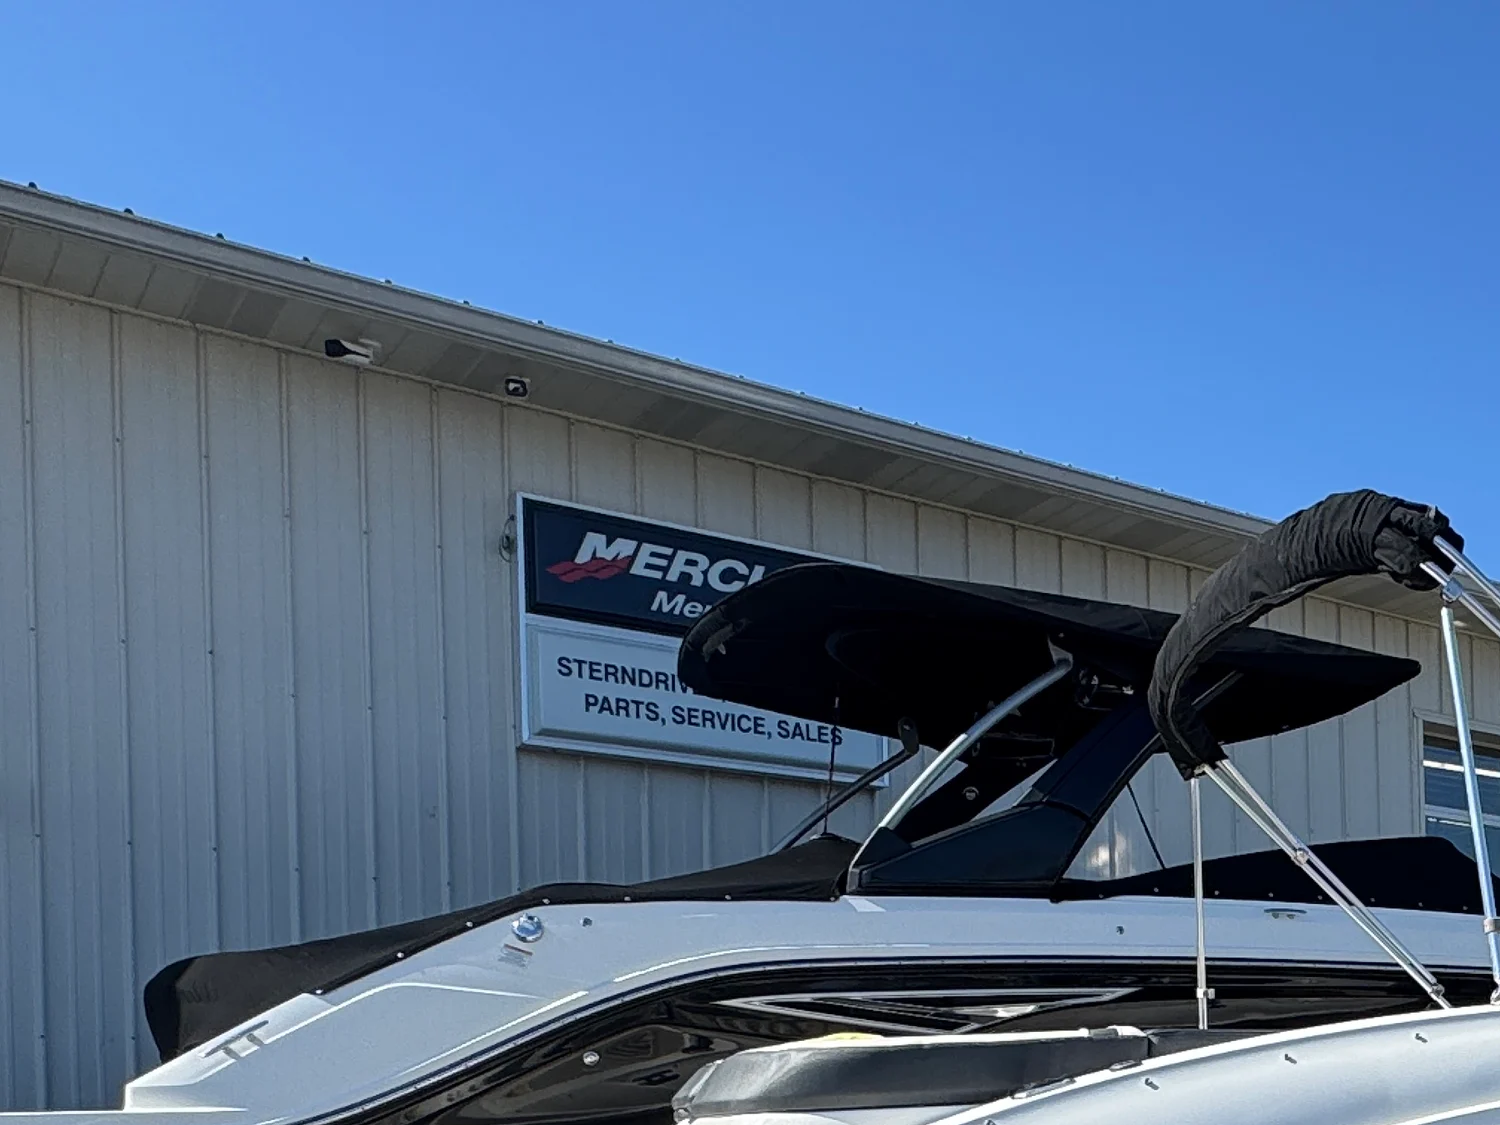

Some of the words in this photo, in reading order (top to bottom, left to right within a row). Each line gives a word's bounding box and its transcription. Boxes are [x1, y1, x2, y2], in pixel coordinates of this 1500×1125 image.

[584, 693, 667, 727] PARTS,
[671, 705, 772, 740] SERVICE,
[777, 719, 843, 746] SALES
